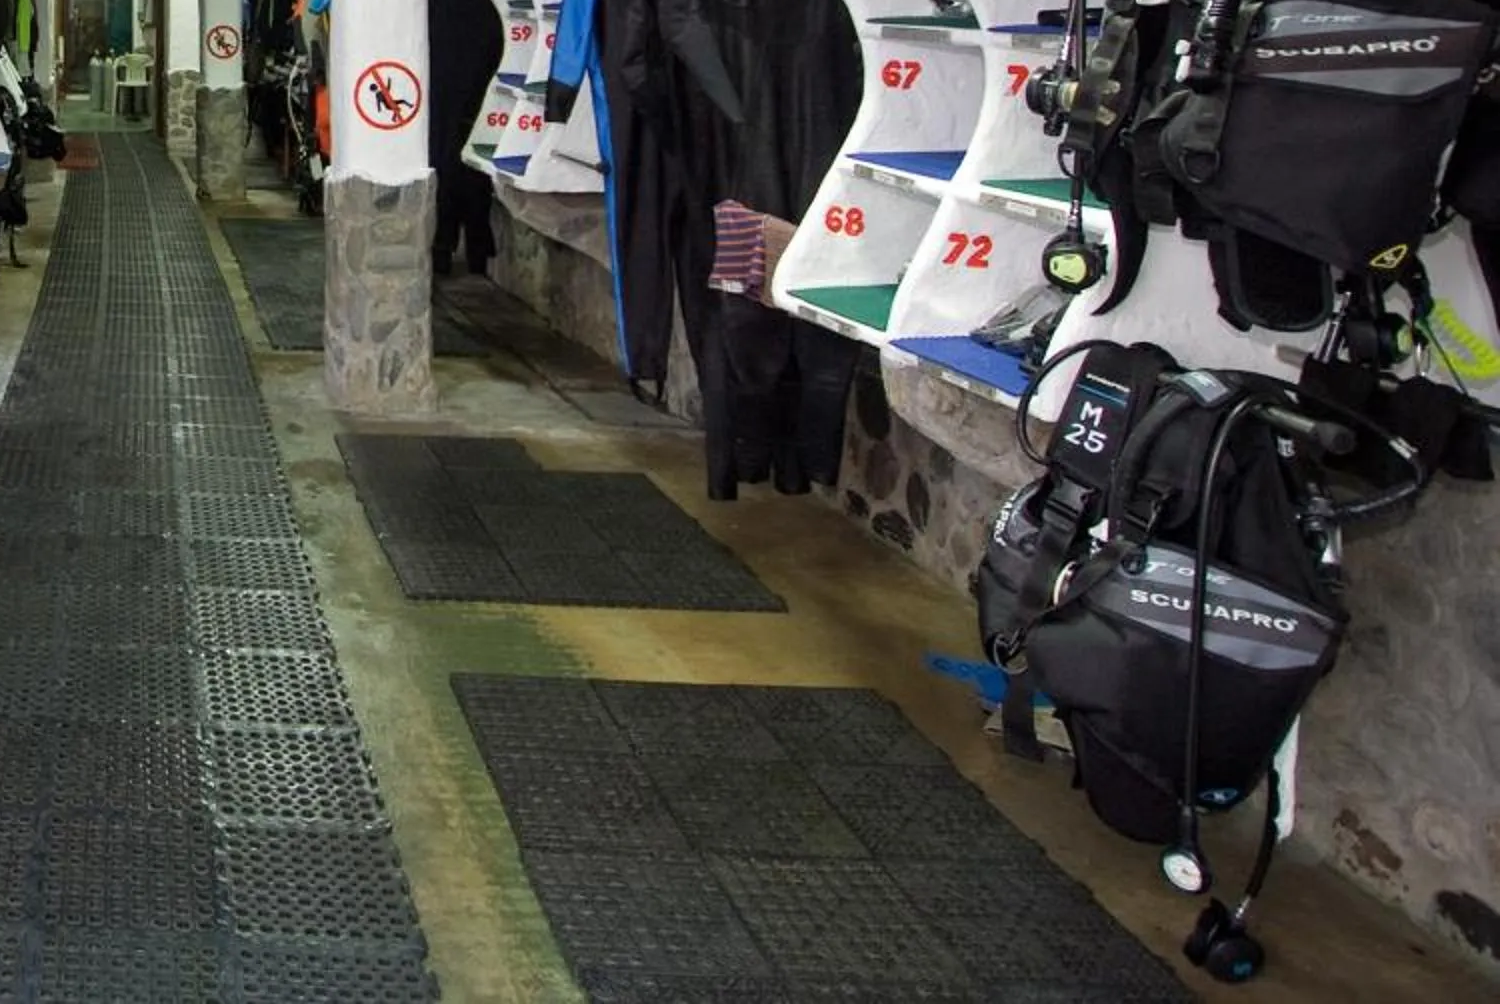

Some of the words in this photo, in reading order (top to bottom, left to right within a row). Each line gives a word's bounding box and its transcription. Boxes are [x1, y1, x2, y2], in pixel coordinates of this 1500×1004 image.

[510, 25, 533, 43] 59
[545, 33, 556, 50] 6
[1255, 37, 1440, 59] SCUBAPRO
[879, 59, 923, 90] 67
[1006, 63, 1030, 95] 7
[486, 111, 509, 128] 60
[517, 114, 544, 133] 64
[824, 204, 865, 237] 68
[943, 232, 994, 270] 72
[1080, 401, 1104, 428] M
[1063, 423, 1109, 453] 25
